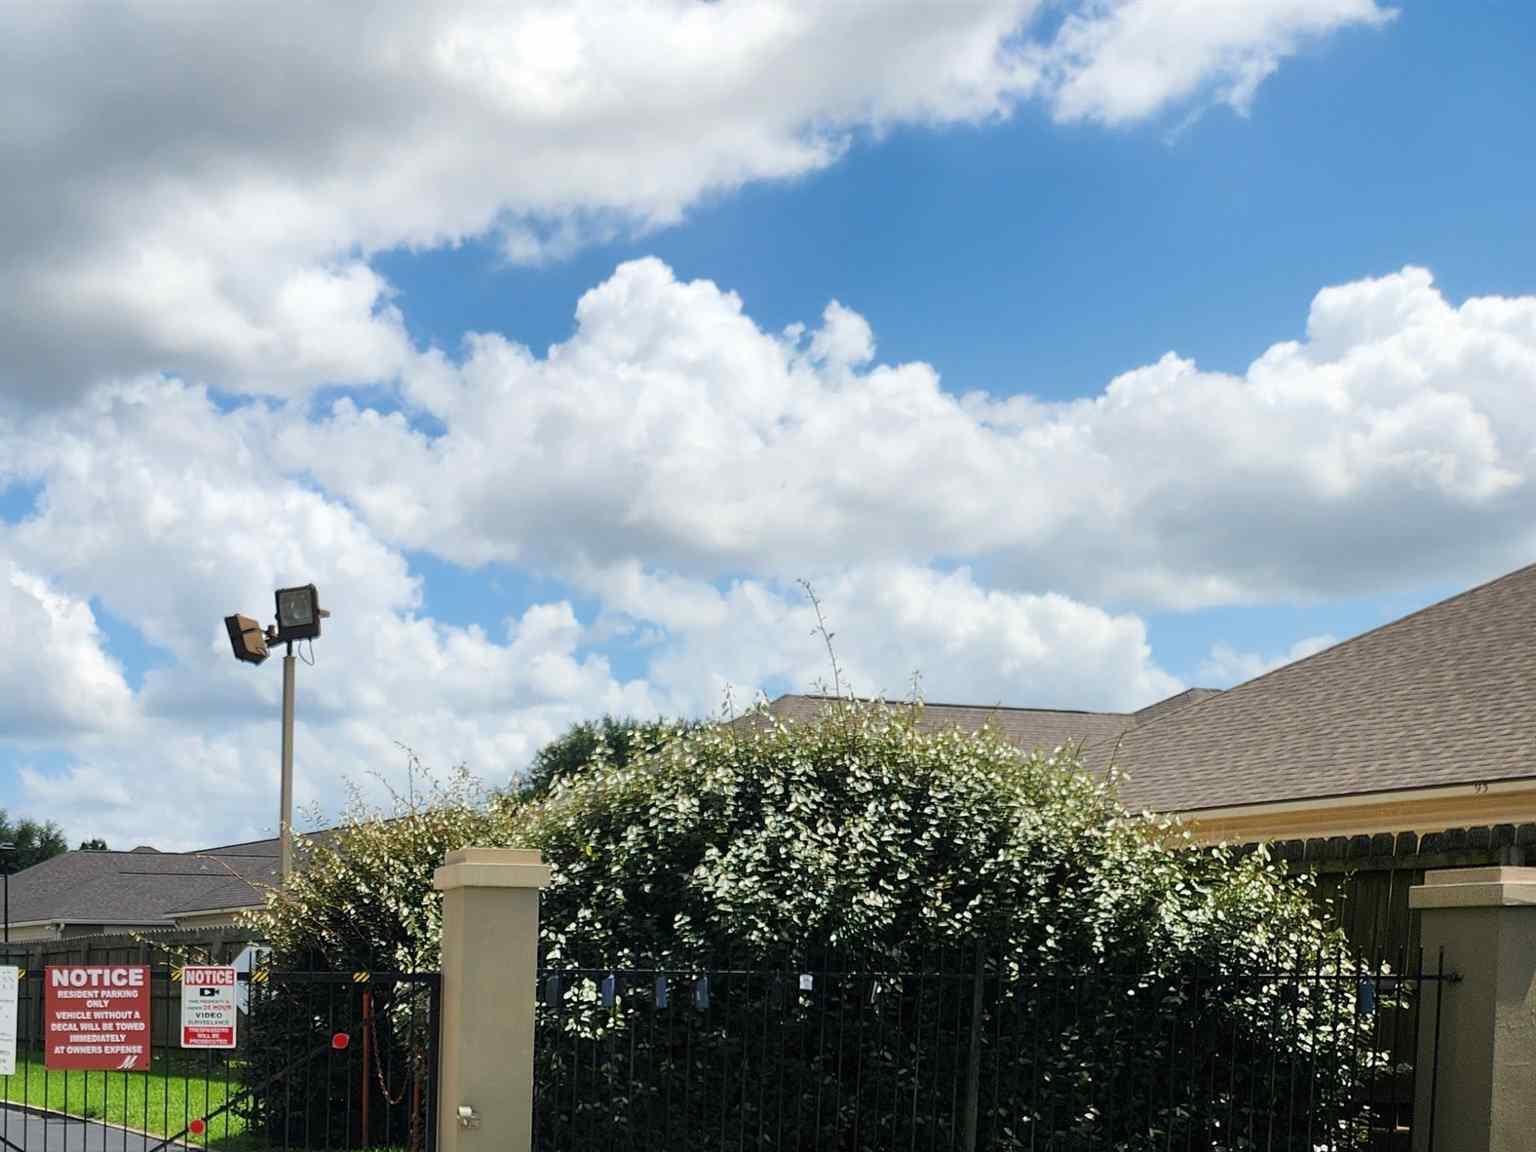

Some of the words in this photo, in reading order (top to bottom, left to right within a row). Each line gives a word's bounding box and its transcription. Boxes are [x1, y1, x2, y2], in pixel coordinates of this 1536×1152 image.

[51, 968, 145, 987] NOTICE
[186, 970, 233, 985] NOTICE
[57, 990, 99, 999] RESIDENT
[100, 990, 139, 999] PARKING
[86, 999, 110, 1008] ONLY
[55, 1011, 92, 1020] VEHICLE
[93, 1011, 132, 1020] WITHOUT
[133, 1011, 141, 1019] A
[195, 1011, 223, 1019] VIDEO
[50, 1023, 80, 1031] DECAL
[80, 1023, 101, 1031] WILL
[102, 1023, 114, 1031] BE
[115, 1022, 146, 1031] TOWED
[69, 1034, 127, 1043] IMMEDIATELY
[54, 1046, 66, 1054] AT
[66, 1046, 102, 1054] OWNERS
[103, 1046, 144, 1054] EXPENSE
